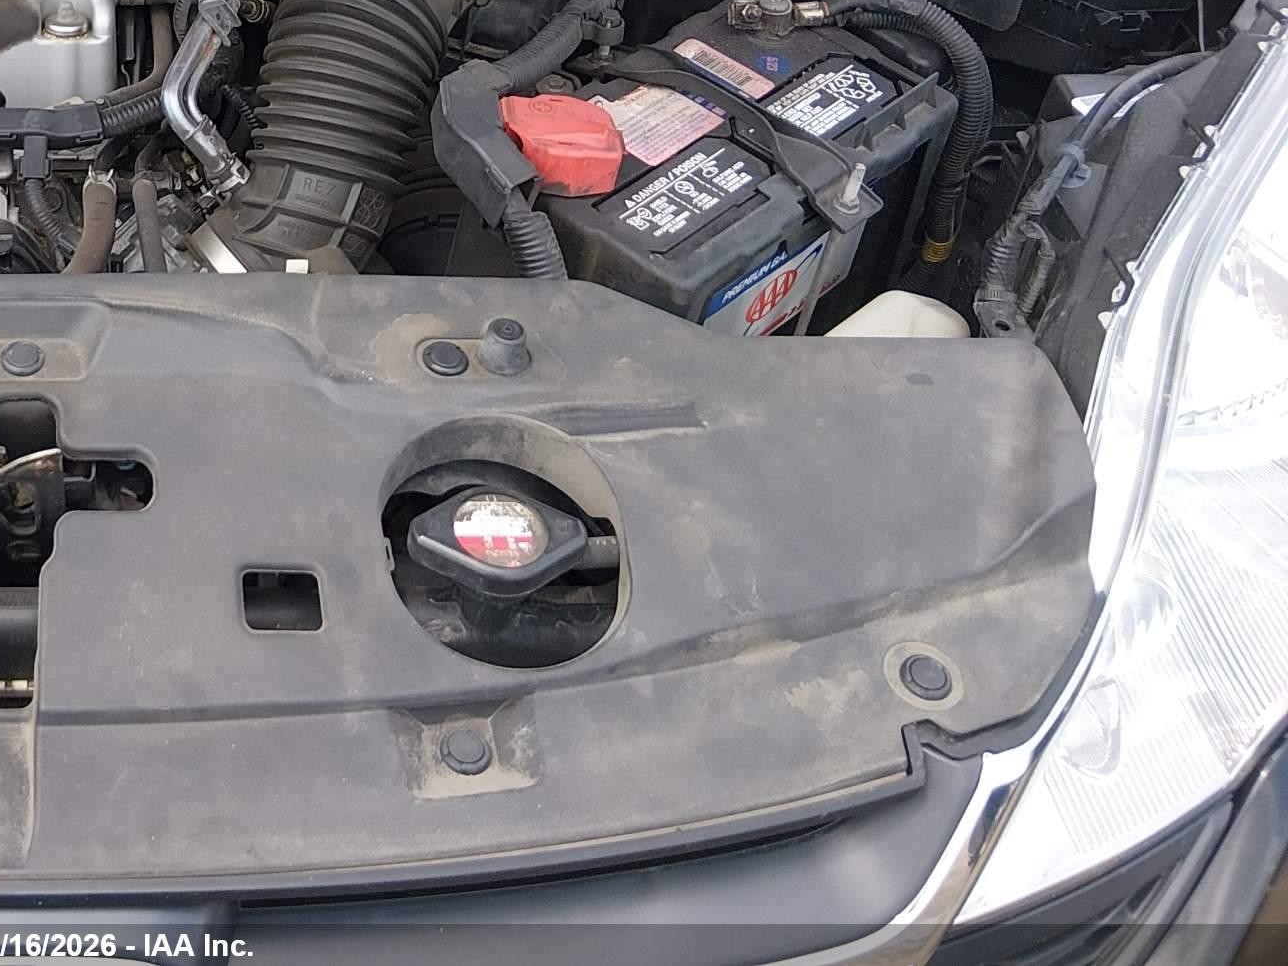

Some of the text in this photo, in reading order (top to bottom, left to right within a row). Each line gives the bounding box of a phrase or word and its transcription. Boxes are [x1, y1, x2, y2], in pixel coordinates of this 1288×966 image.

[633, 176, 671, 202] DANGER
[672, 152, 707, 176] POISON
[748, 272, 797, 322] AAA
